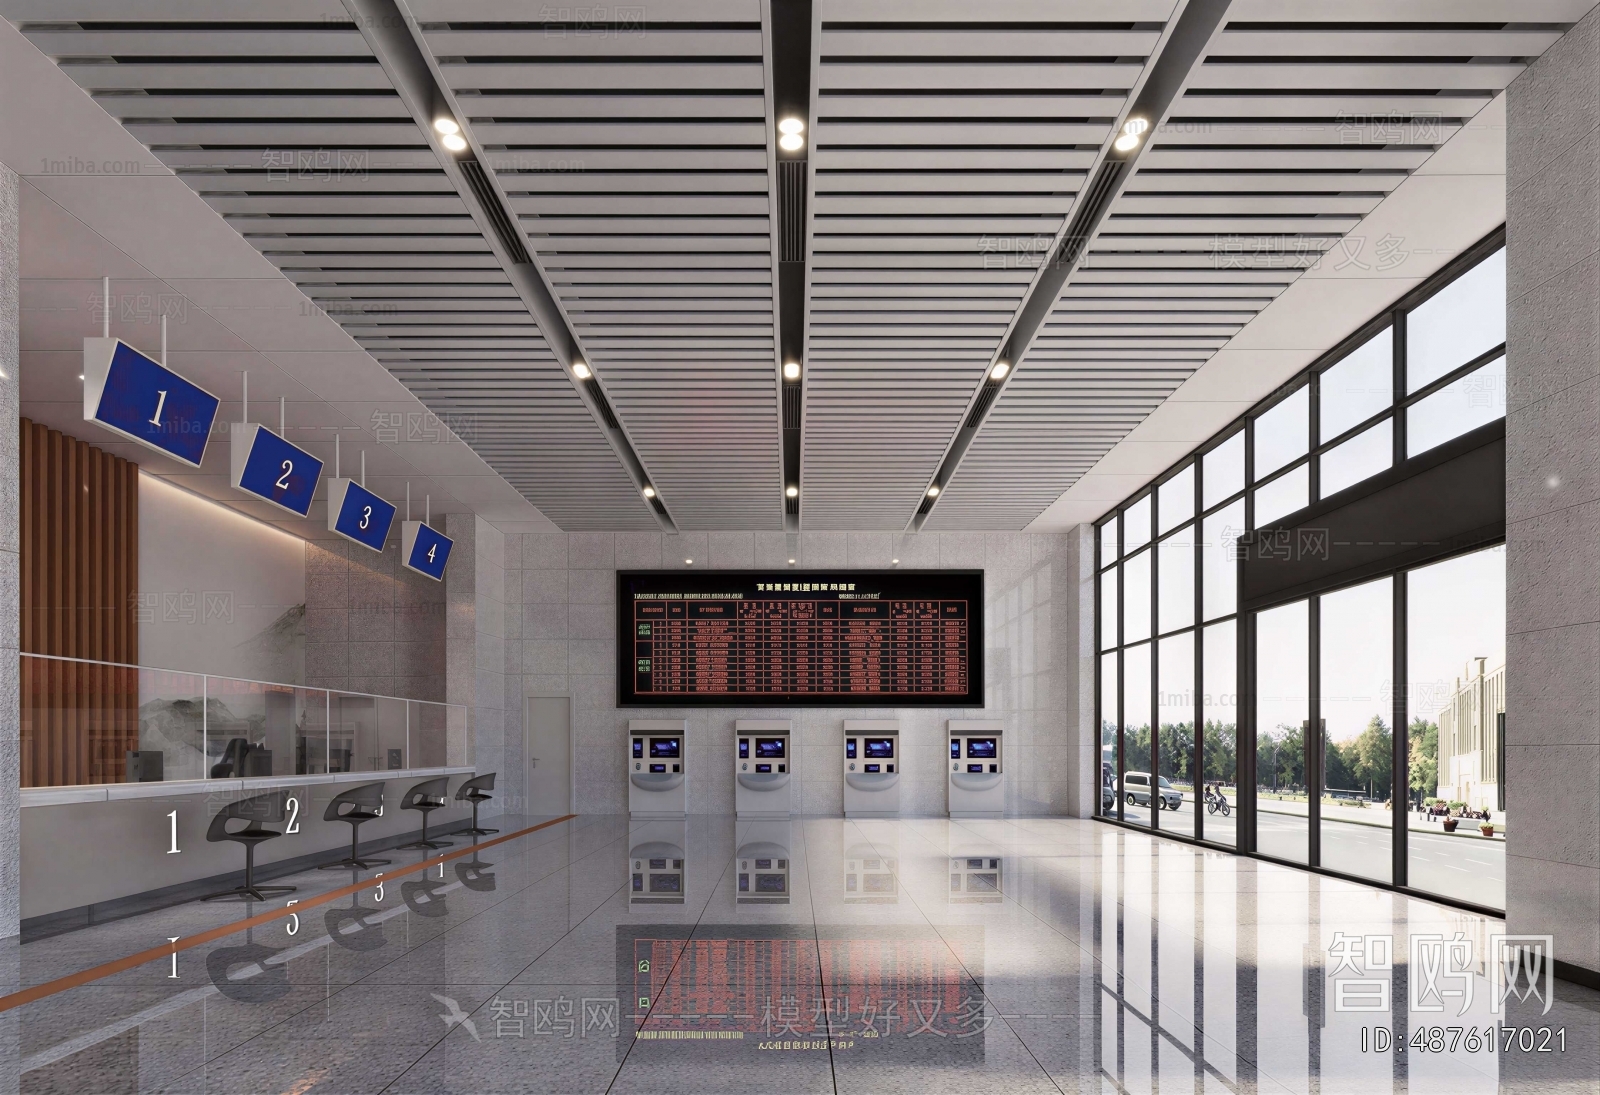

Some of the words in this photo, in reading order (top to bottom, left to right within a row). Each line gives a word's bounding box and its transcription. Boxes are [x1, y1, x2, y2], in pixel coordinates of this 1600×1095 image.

[148, 390, 167, 427] 1
[275, 459, 293, 490] 2
[359, 505, 372, 529] 3
[427, 543, 438, 563] 4
[166, 809, 182, 854] 1
[285, 797, 300, 834] 2
